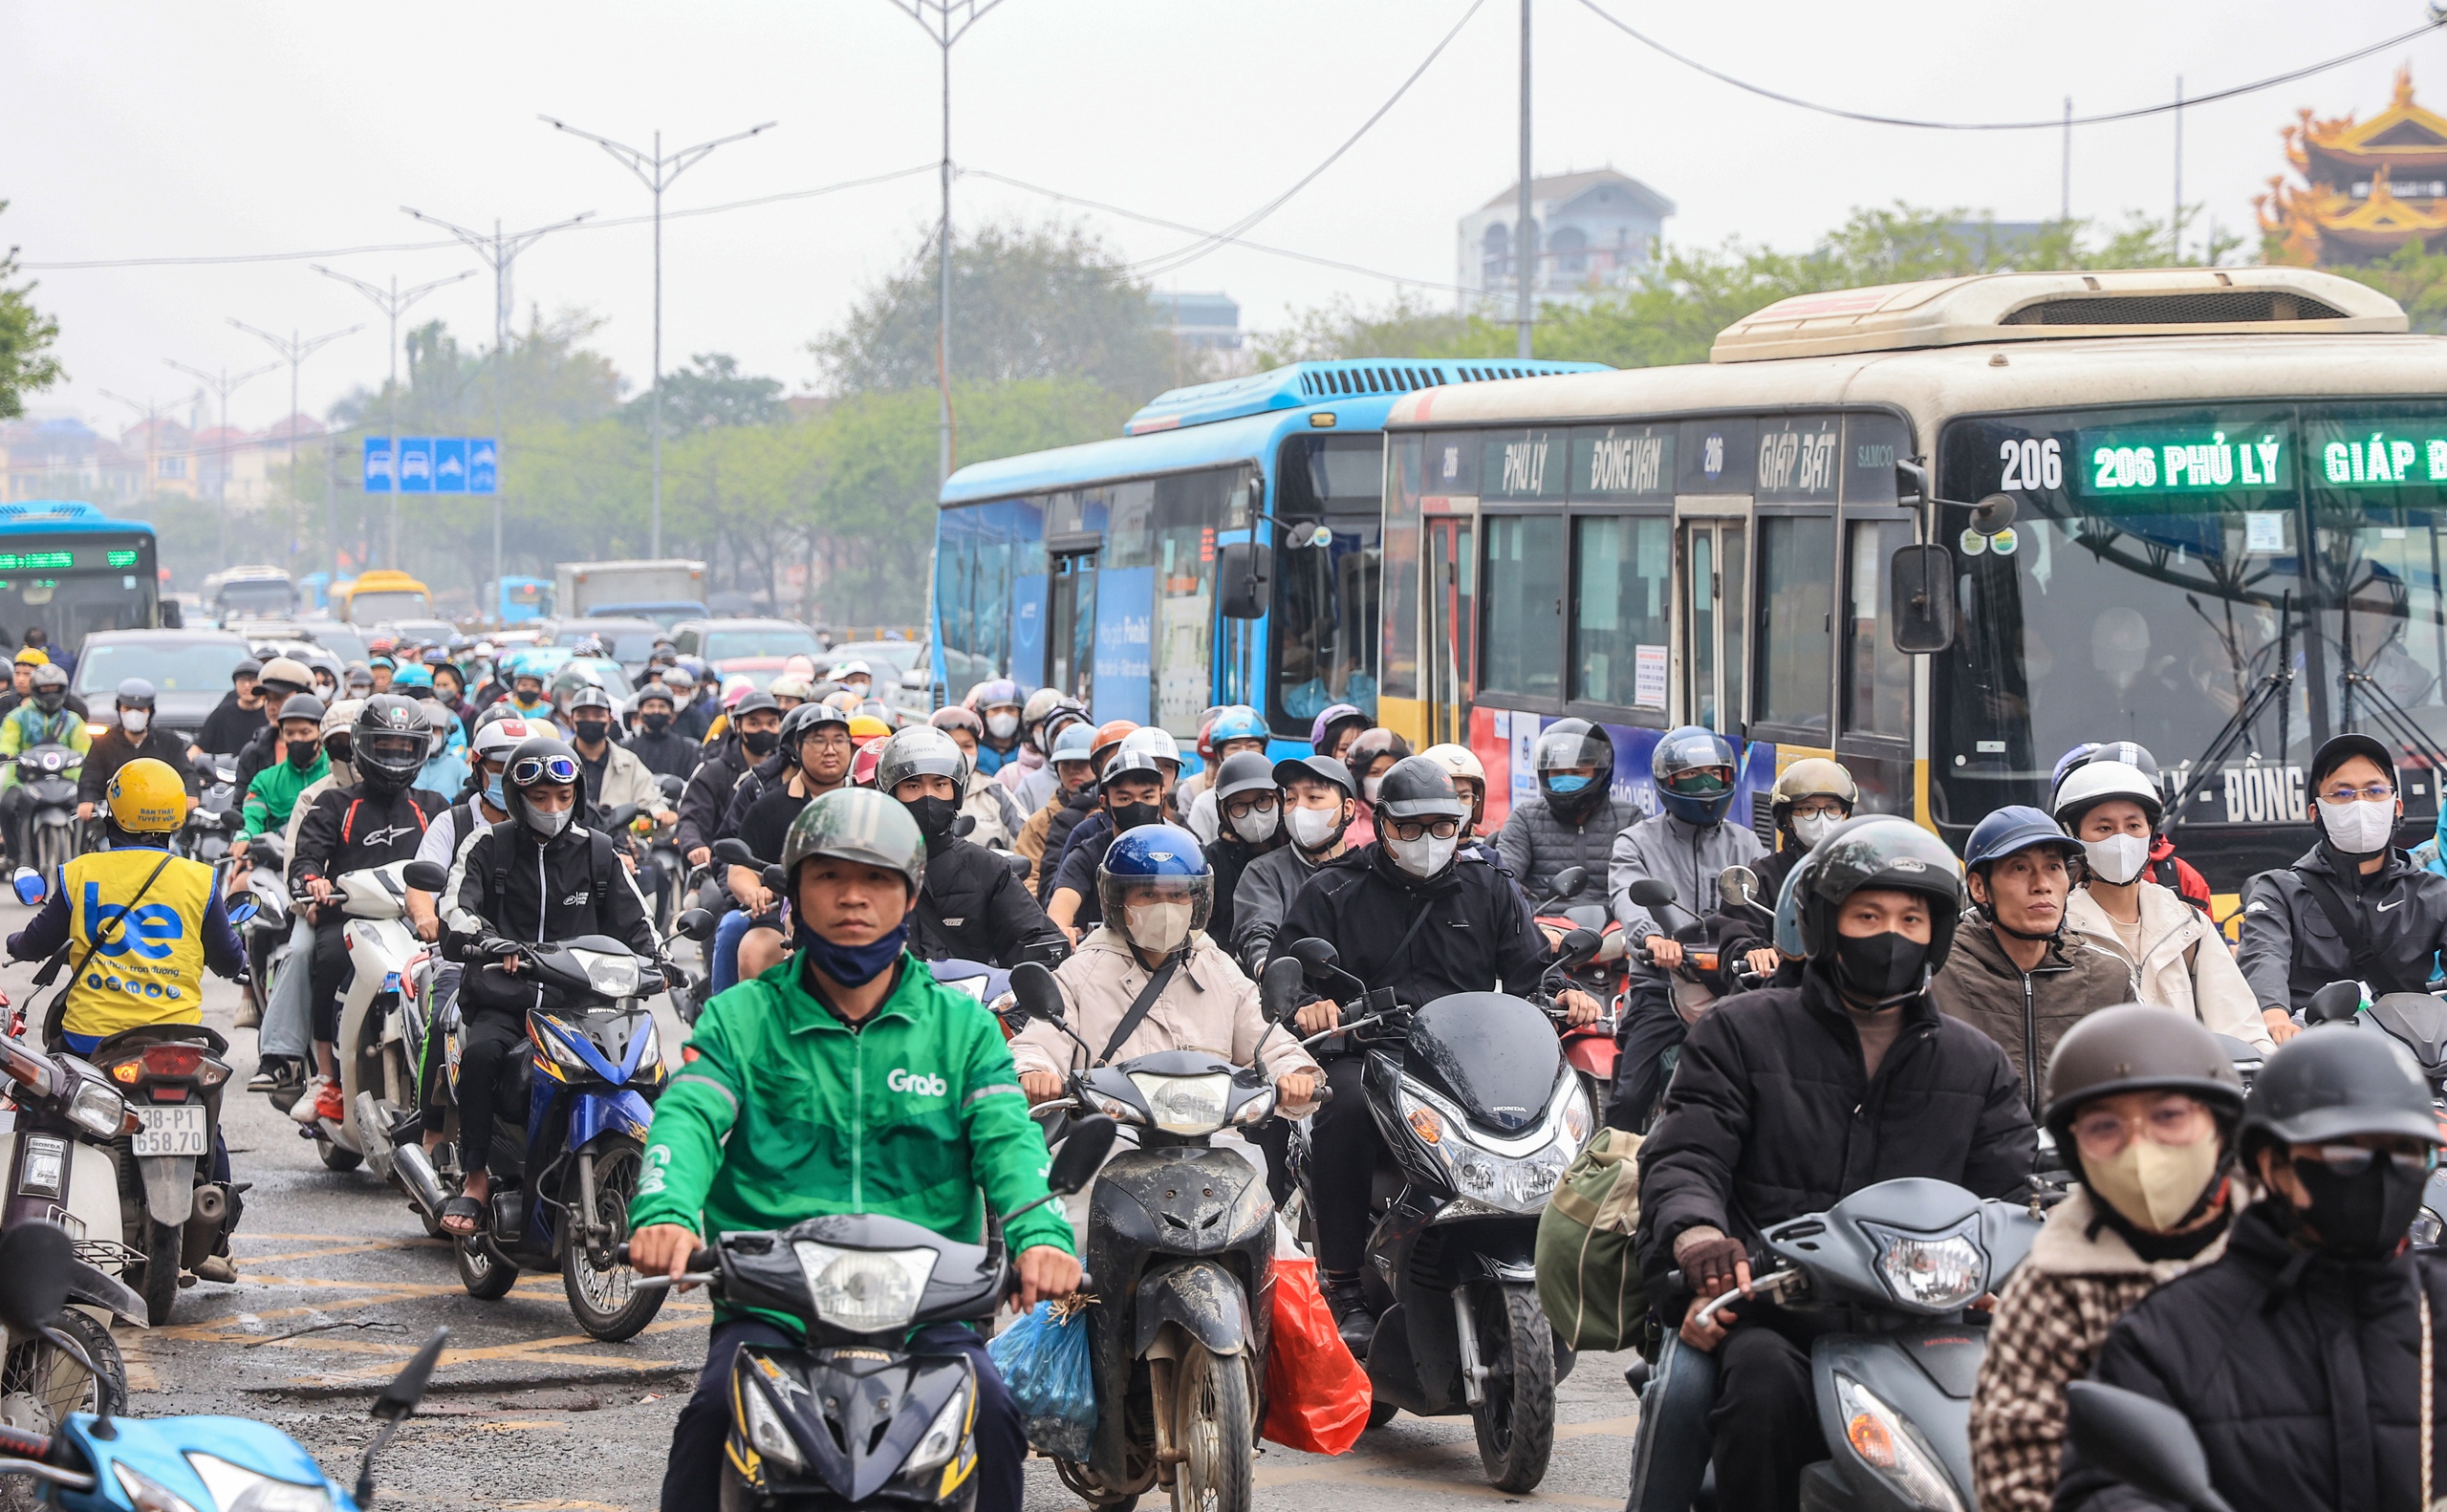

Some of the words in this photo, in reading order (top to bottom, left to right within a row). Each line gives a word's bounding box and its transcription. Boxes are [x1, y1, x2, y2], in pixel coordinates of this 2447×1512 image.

[1529, 432, 1548, 497] LÝ
[1704, 436, 1723, 473] 206
[1760, 421, 1799, 493] GIÁP
[1799, 421, 1836, 494] BÁT
[1857, 444, 1895, 468] SAMCO
[2000, 438, 2063, 491] 206
[2093, 446, 2157, 488] 206
[2162, 431, 2234, 486] PHỦ
[2239, 434, 2280, 486] LÝ
[2324, 432, 2415, 484] GIÁP
[2223, 750, 2308, 823] ĐỒNG
[84, 881, 184, 960] be
[130, 964, 149, 975] trọn
[887, 1068, 947, 1098] Grab
[142, 1109, 194, 1130] 38-P1
[1492, 1105, 1527, 1113] HONDA
[32, 1141, 62, 1151] HONDA
[137, 1132, 203, 1153] 658.70
[834, 1350, 892, 1363] HONDA
